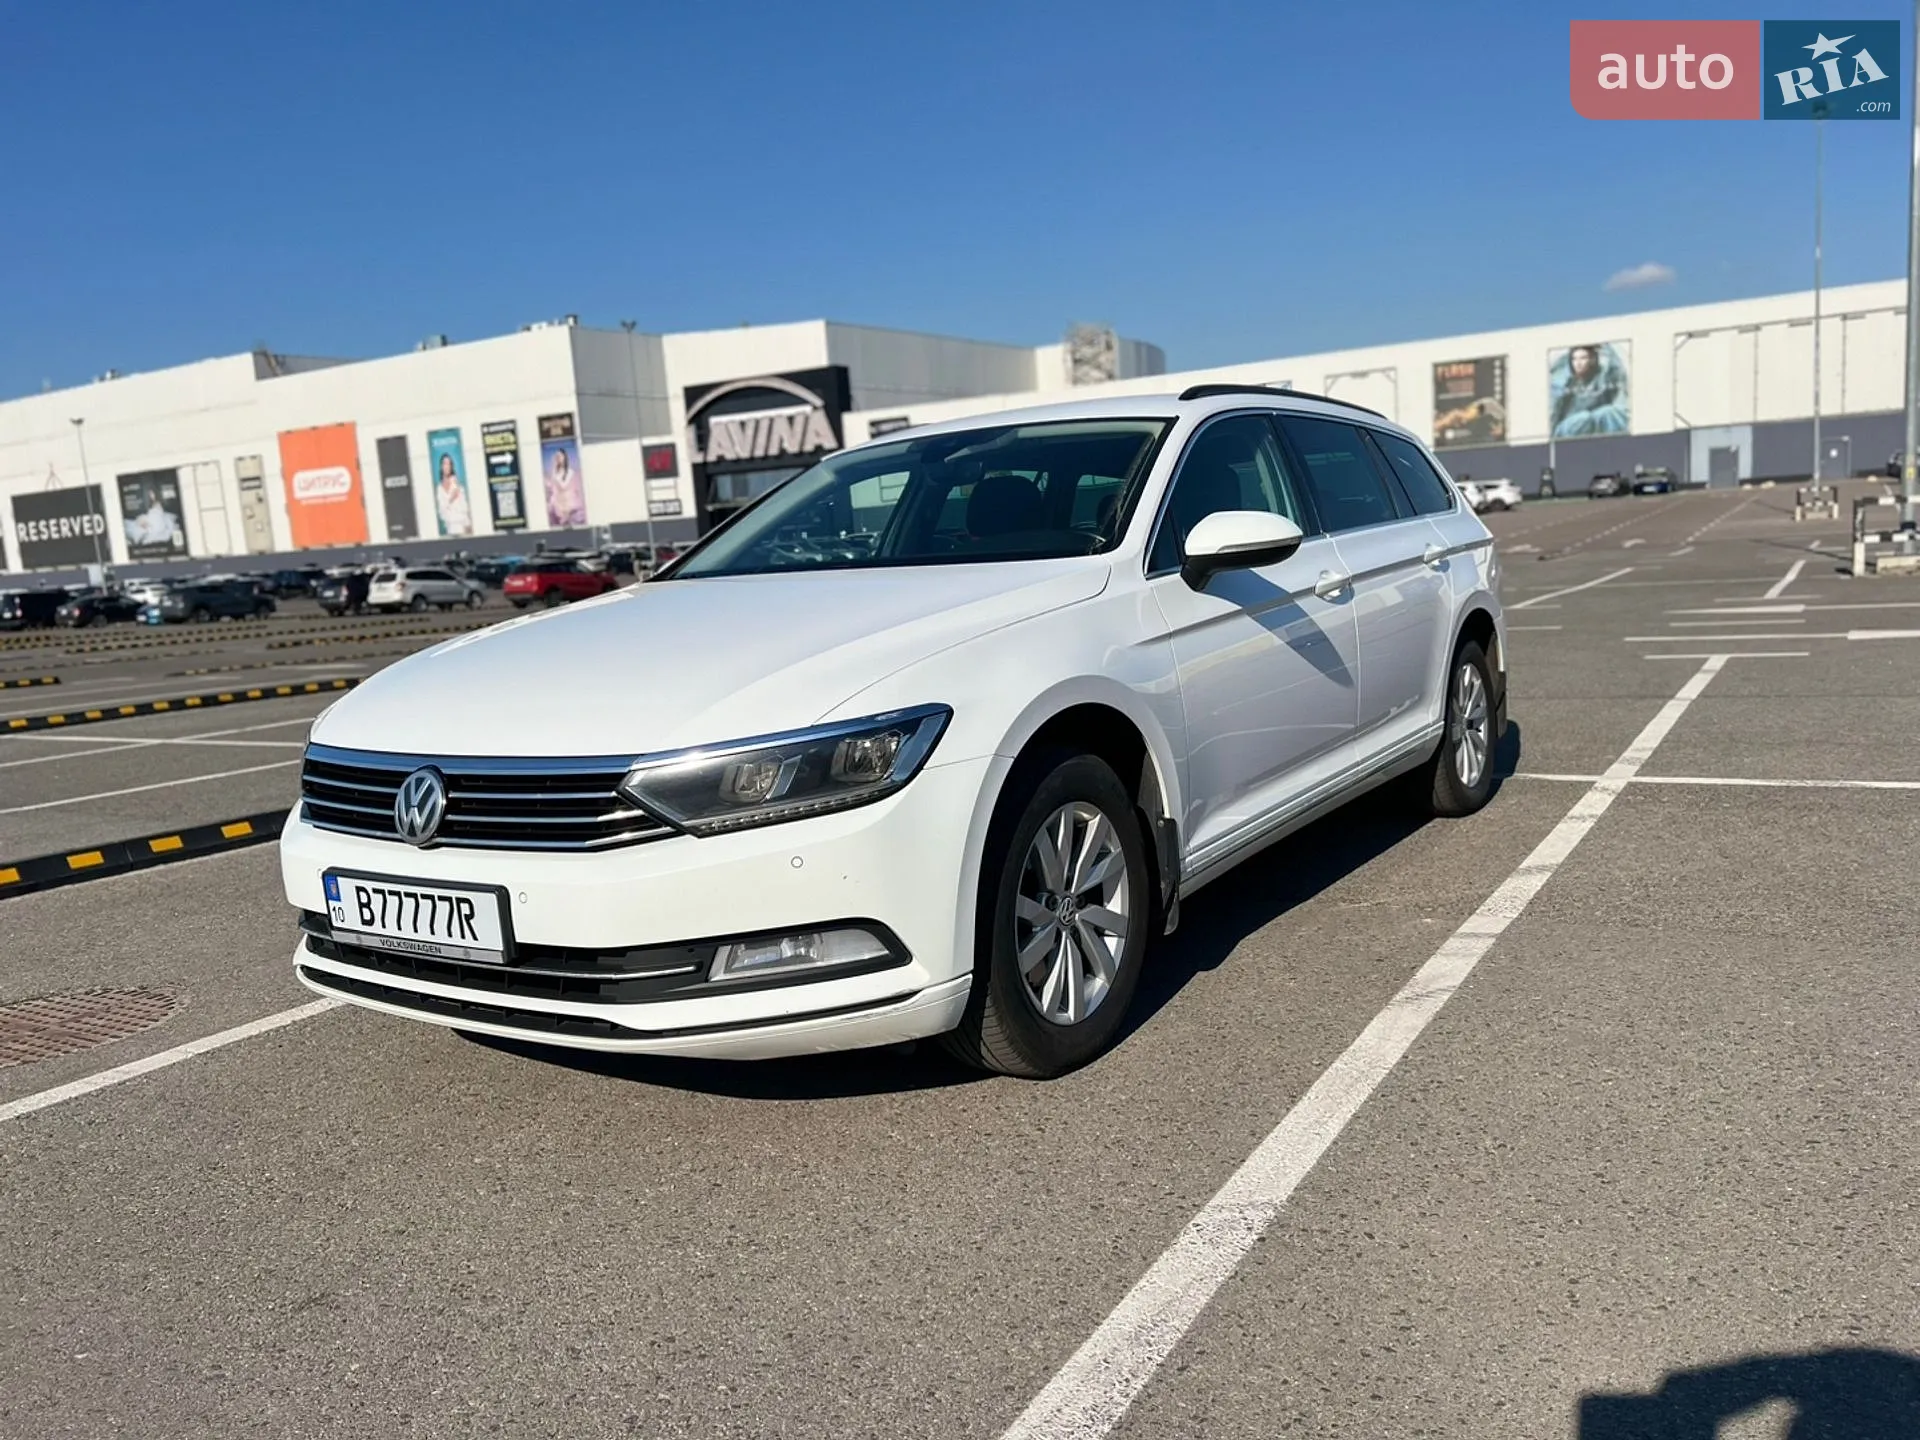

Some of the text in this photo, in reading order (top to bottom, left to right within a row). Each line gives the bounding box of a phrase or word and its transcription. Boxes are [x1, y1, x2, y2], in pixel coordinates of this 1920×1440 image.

[687, 407, 838, 463] LAVINA
[17, 514, 105, 543] RESERVED
[332, 905, 346, 923] 10
[355, 886, 479, 941] B77777R
[380, 938, 442, 955] VOLKSWAGEN
